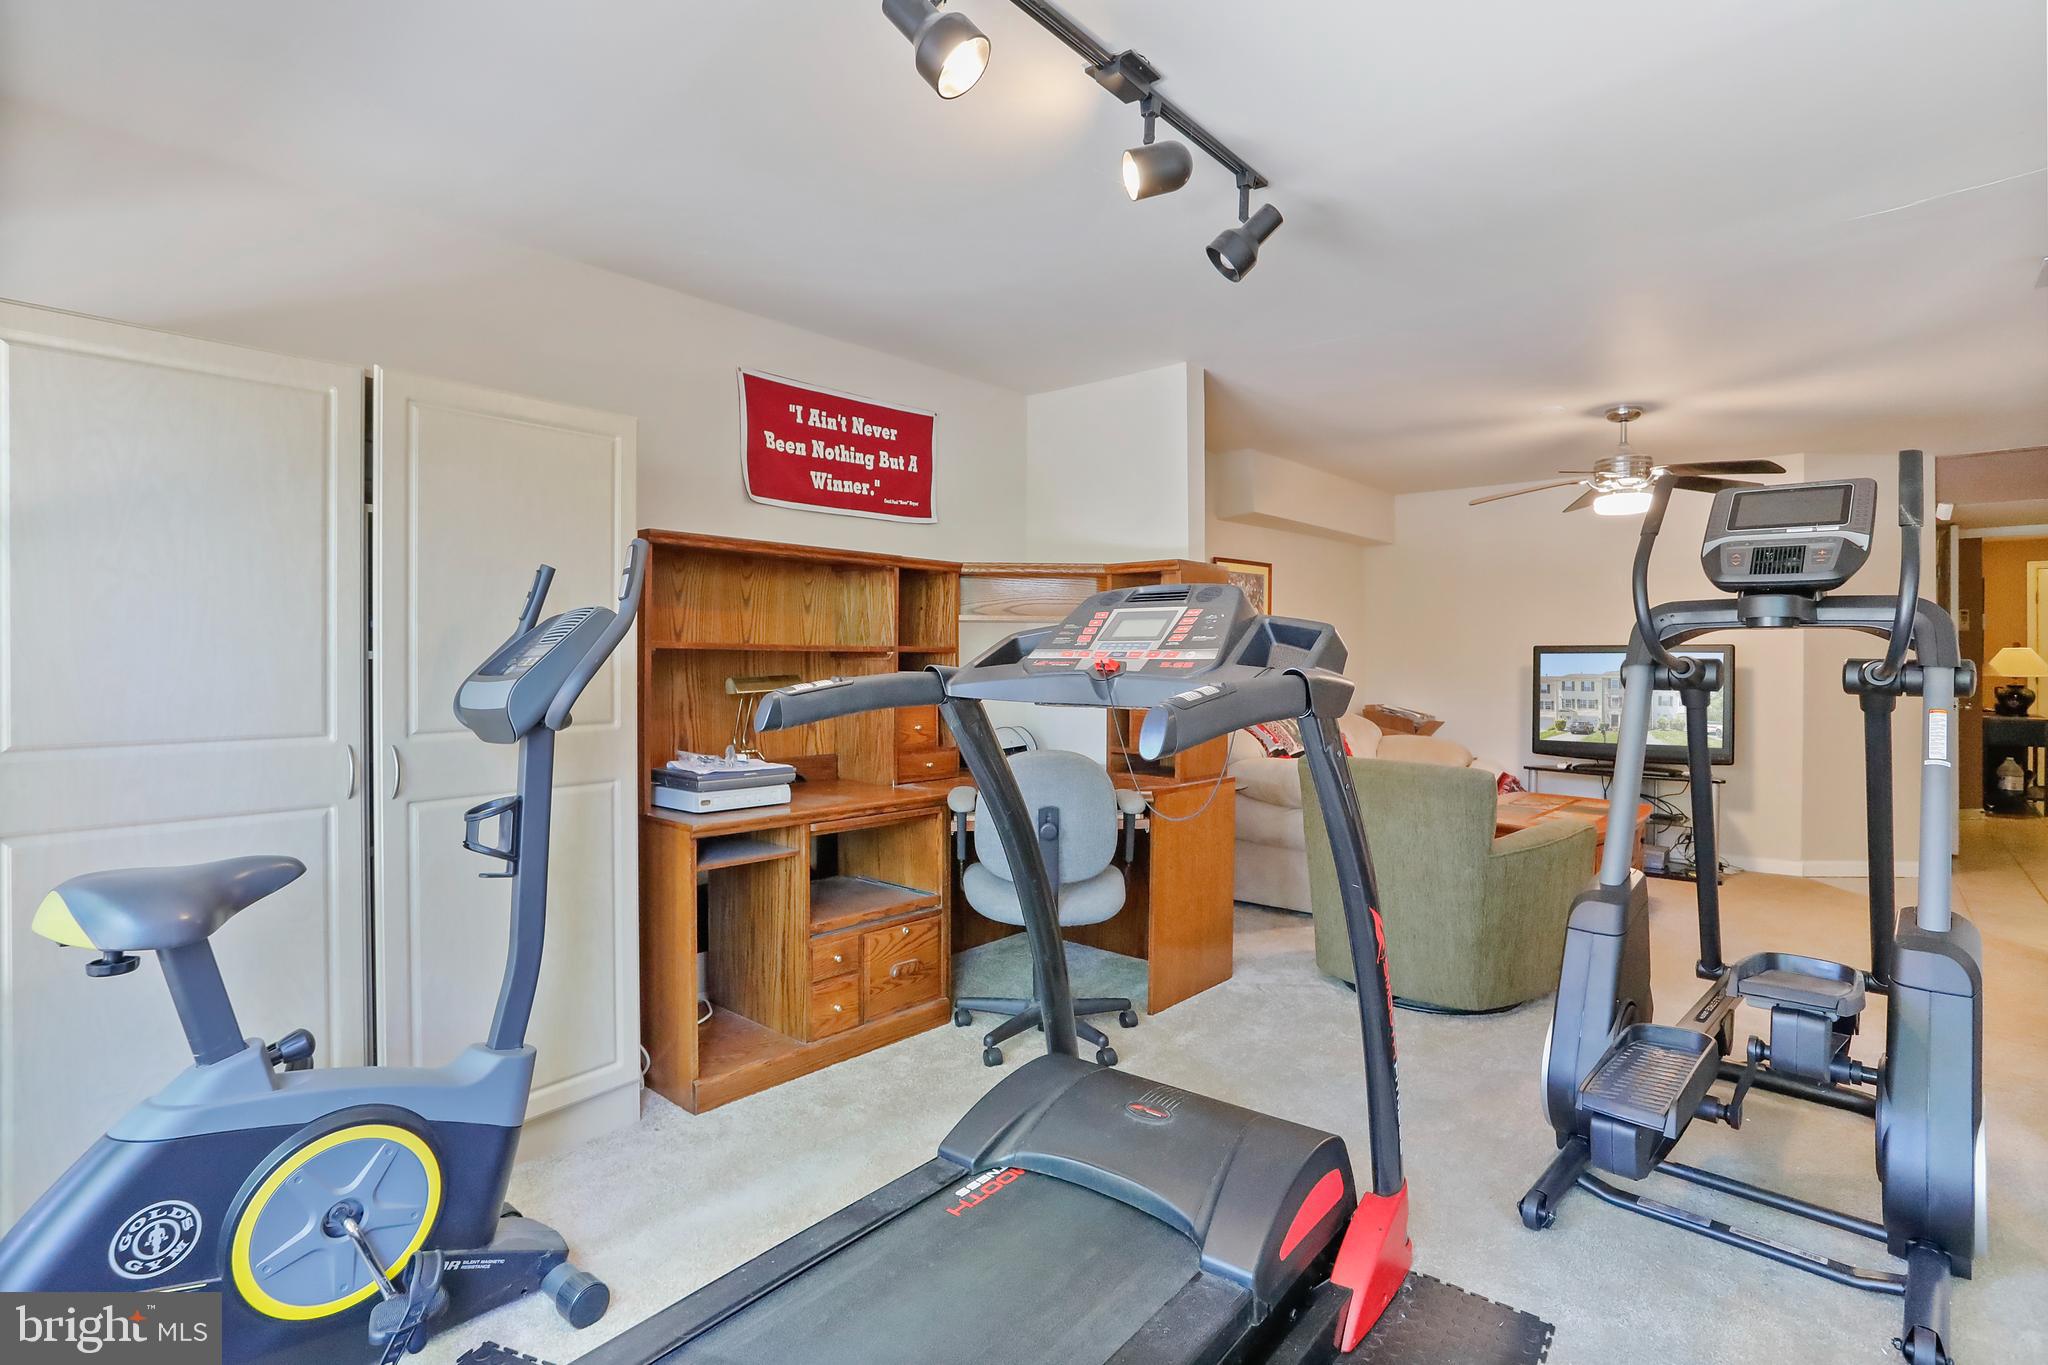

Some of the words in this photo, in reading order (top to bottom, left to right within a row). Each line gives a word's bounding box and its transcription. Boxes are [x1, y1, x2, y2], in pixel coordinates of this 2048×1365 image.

[789, 404, 803, 424] "I
[808, 408, 847, 432] Ain't
[851, 416, 898, 441] Never
[763, 430, 807, 456] Been
[811, 439, 875, 470] Nothing
[879, 450, 905, 471] But
[908, 455, 918, 472] A
[810, 470, 881, 496] Winner."
[118, 1207, 194, 1252] GOLD'S
[124, 1239, 190, 1272] GYM
